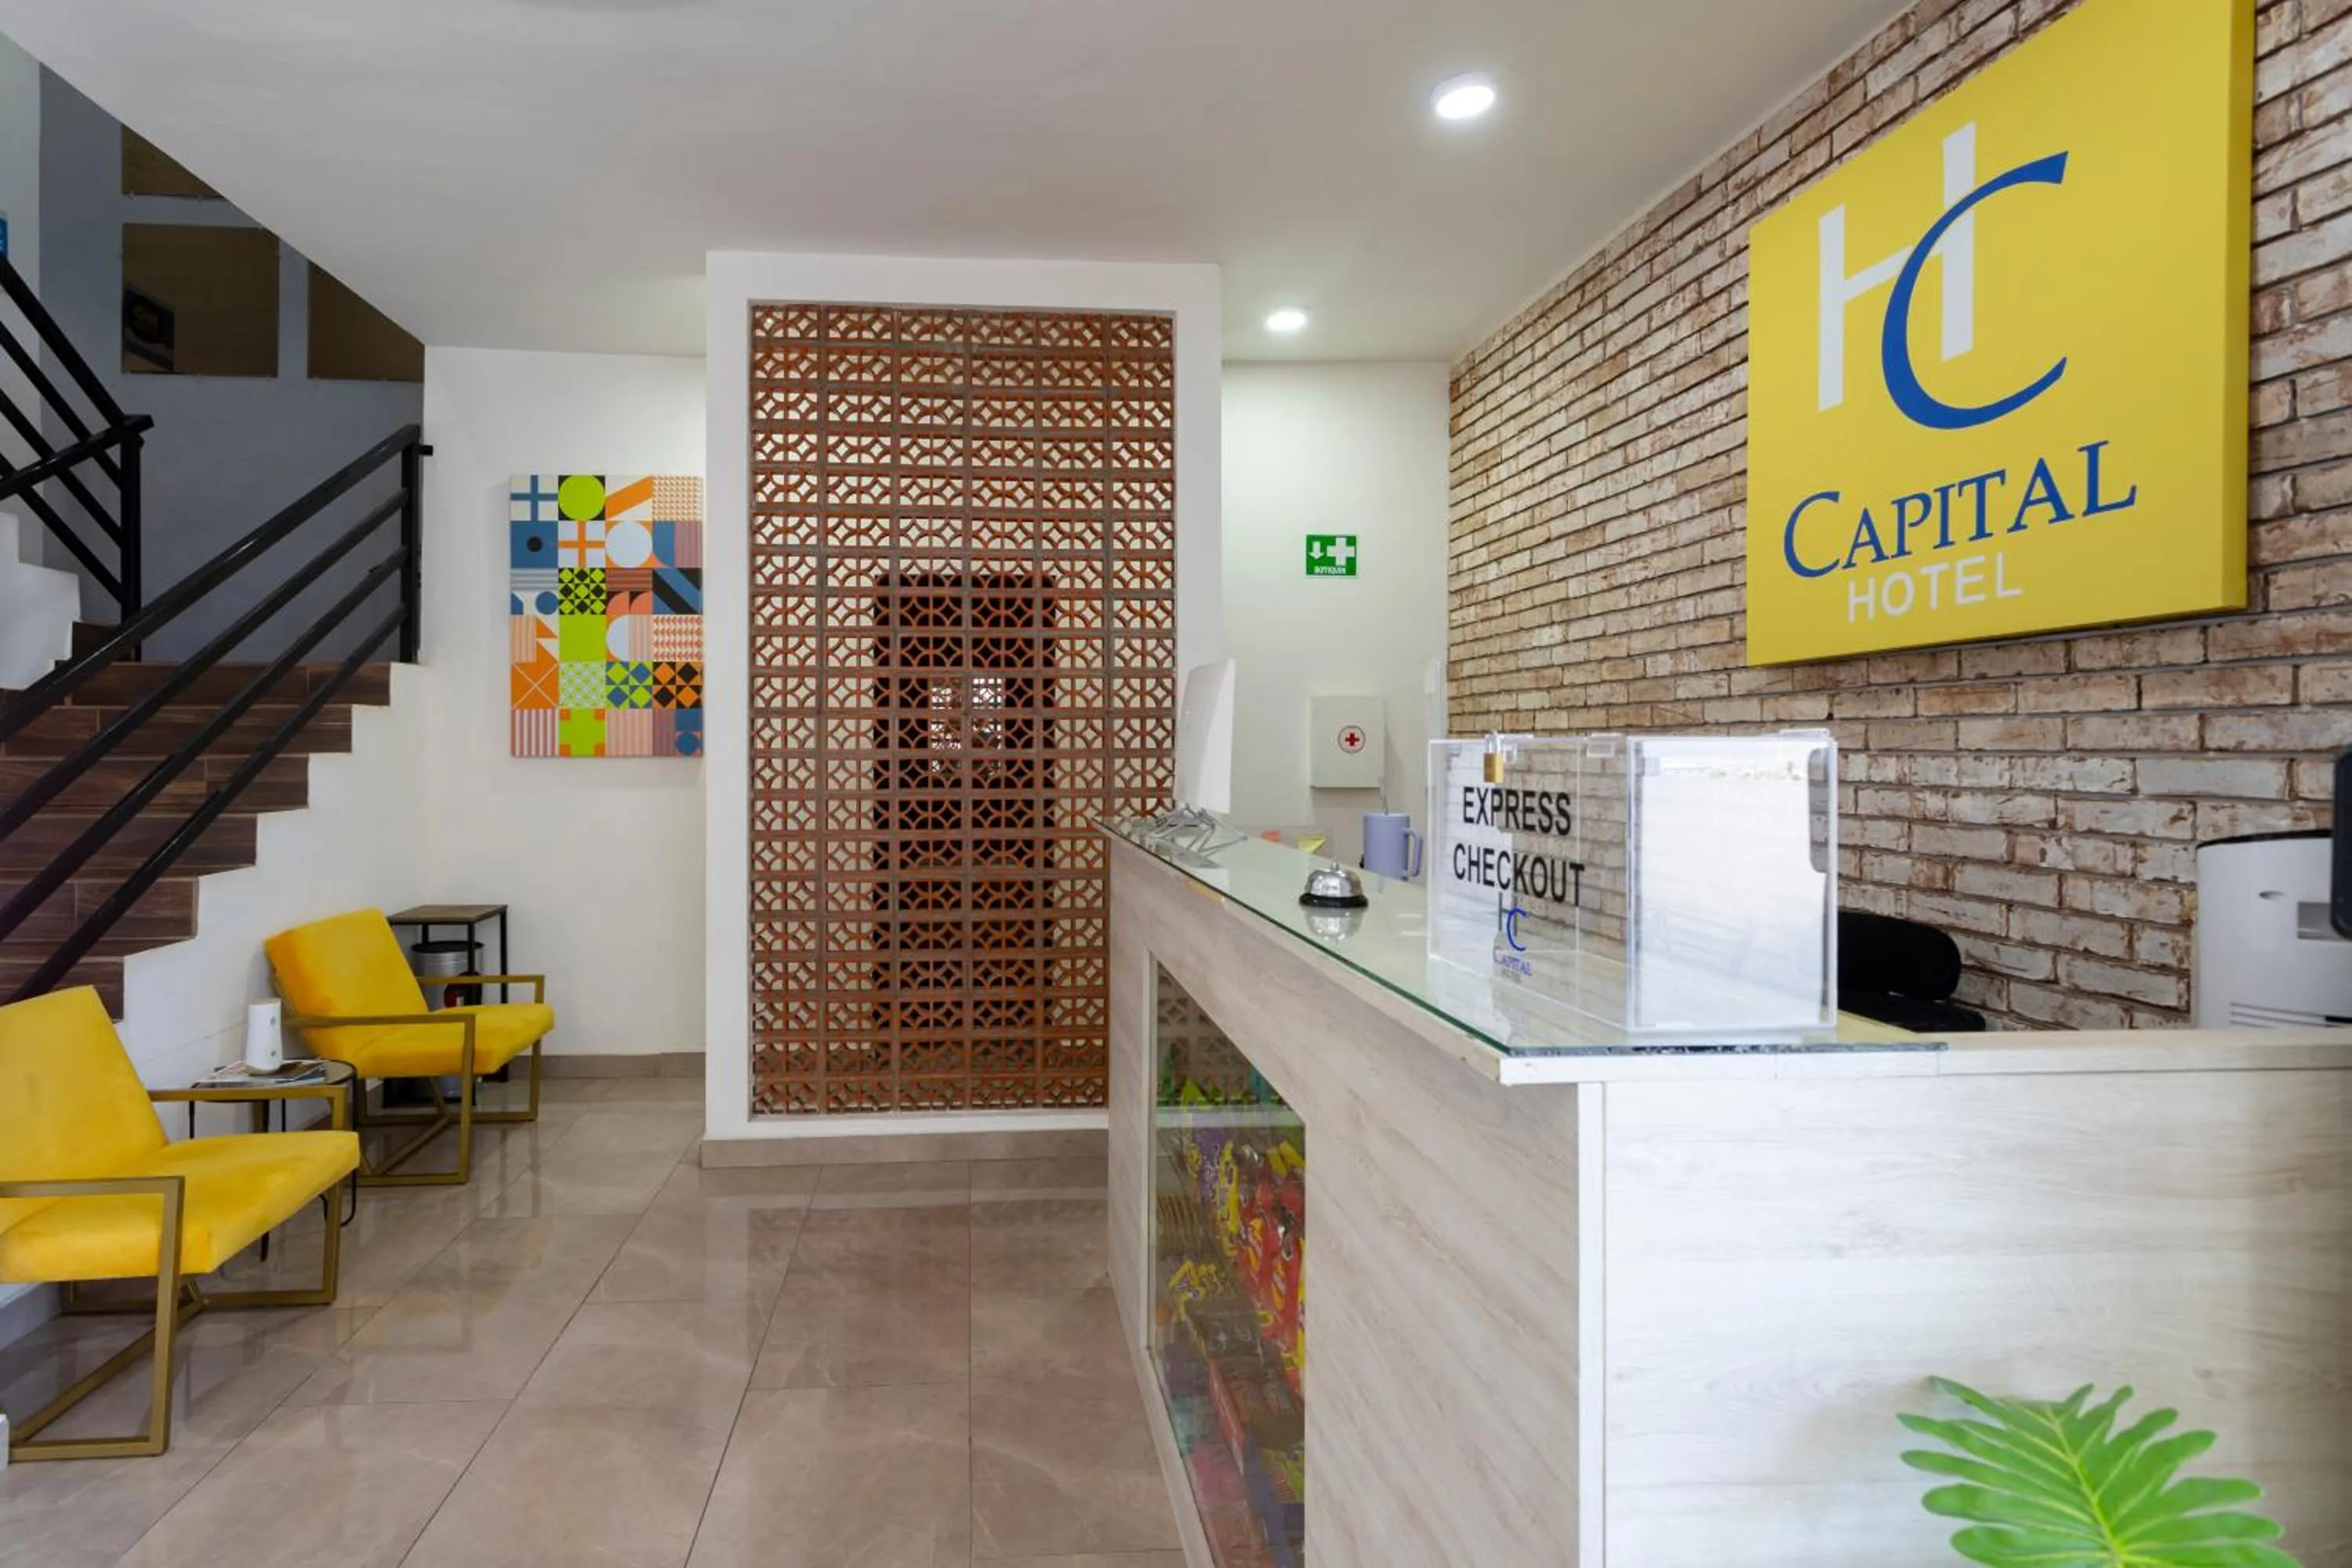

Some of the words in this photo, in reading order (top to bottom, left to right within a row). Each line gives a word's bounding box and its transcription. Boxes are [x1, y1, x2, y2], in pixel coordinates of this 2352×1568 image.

[1784, 440, 2137, 578] CAPITAL
[1847, 551, 2023, 624] HOTEL
[1463, 786, 1571, 836] EXPRESS
[1454, 843, 1585, 907] CHECKOUT
